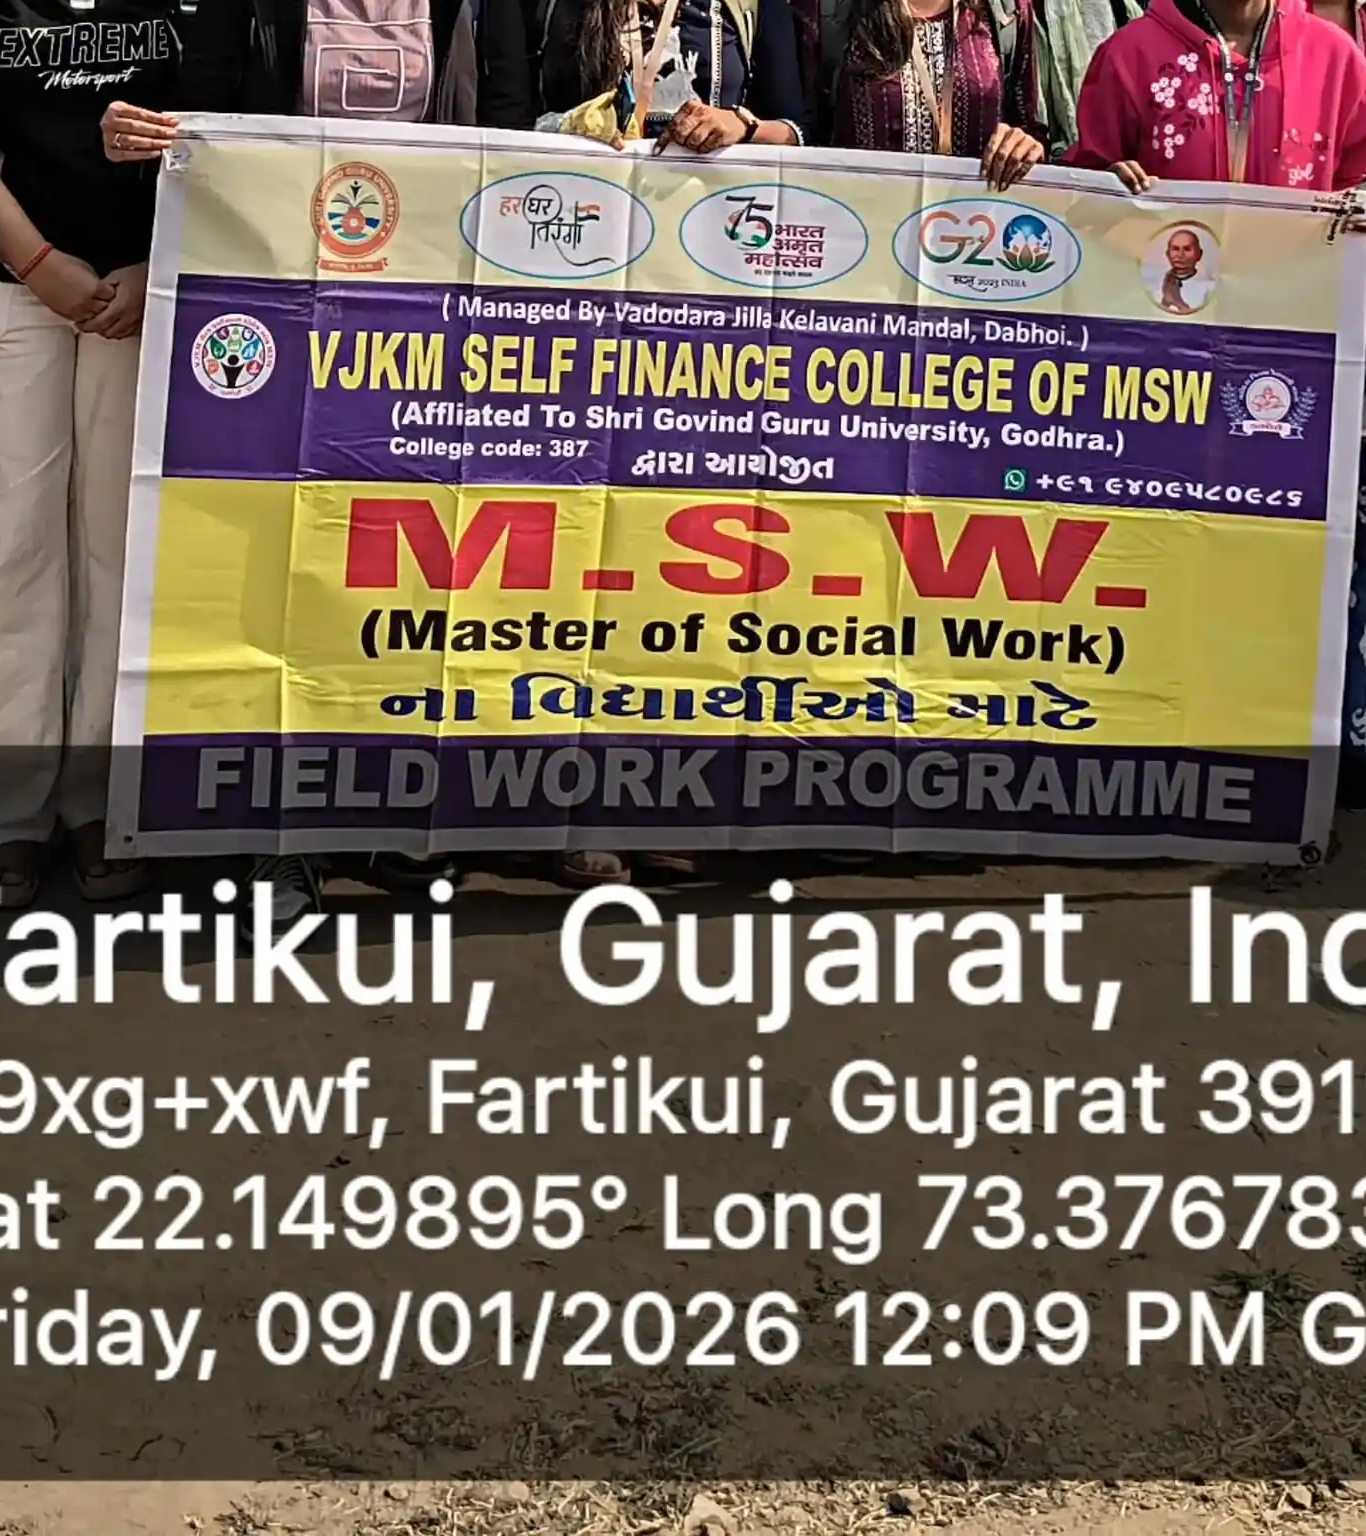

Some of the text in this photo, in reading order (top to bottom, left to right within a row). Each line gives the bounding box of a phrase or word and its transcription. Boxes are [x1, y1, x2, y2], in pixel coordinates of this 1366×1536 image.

[37, 65, 143, 92] Motorsport
[500, 196, 553, 217] हर घर
[725, 195, 775, 249] 75
[775, 224, 825, 239] भारत
[772, 238, 825, 256] अमृत
[458, 296, 573, 326] Managed
[579, 300, 608, 327] By
[614, 302, 725, 328] Vadodara
[731, 306, 772, 330] Jilla
[780, 311, 877, 337] Kelavani
[883, 315, 977, 344] Mandal,
[985, 321, 1073, 347] Dabhoi.
[308, 330, 445, 392] VJKM
[459, 333, 577, 395] SELF
[590, 336, 792, 404] FINANCE
[806, 346, 1018, 414] COLLEGE
[1029, 359, 1090, 417] OF
[1102, 365, 1212, 426] MSW
[389, 436, 590, 460] College code: 387
[391, 400, 1125, 458] (Affliated To Shri Govind Guru University, Godhra.)
[631, 444, 835, 485] દ્વારા આયોજીત
[344, 497, 1148, 609] M.S.W.
[360, 608, 1125, 674] (Master of Social Work)
[379, 687, 478, 724] ના
[946, 679, 1098, 731] માટે
[196, 746, 1255, 825] FIELD WORK PROGRAMME
